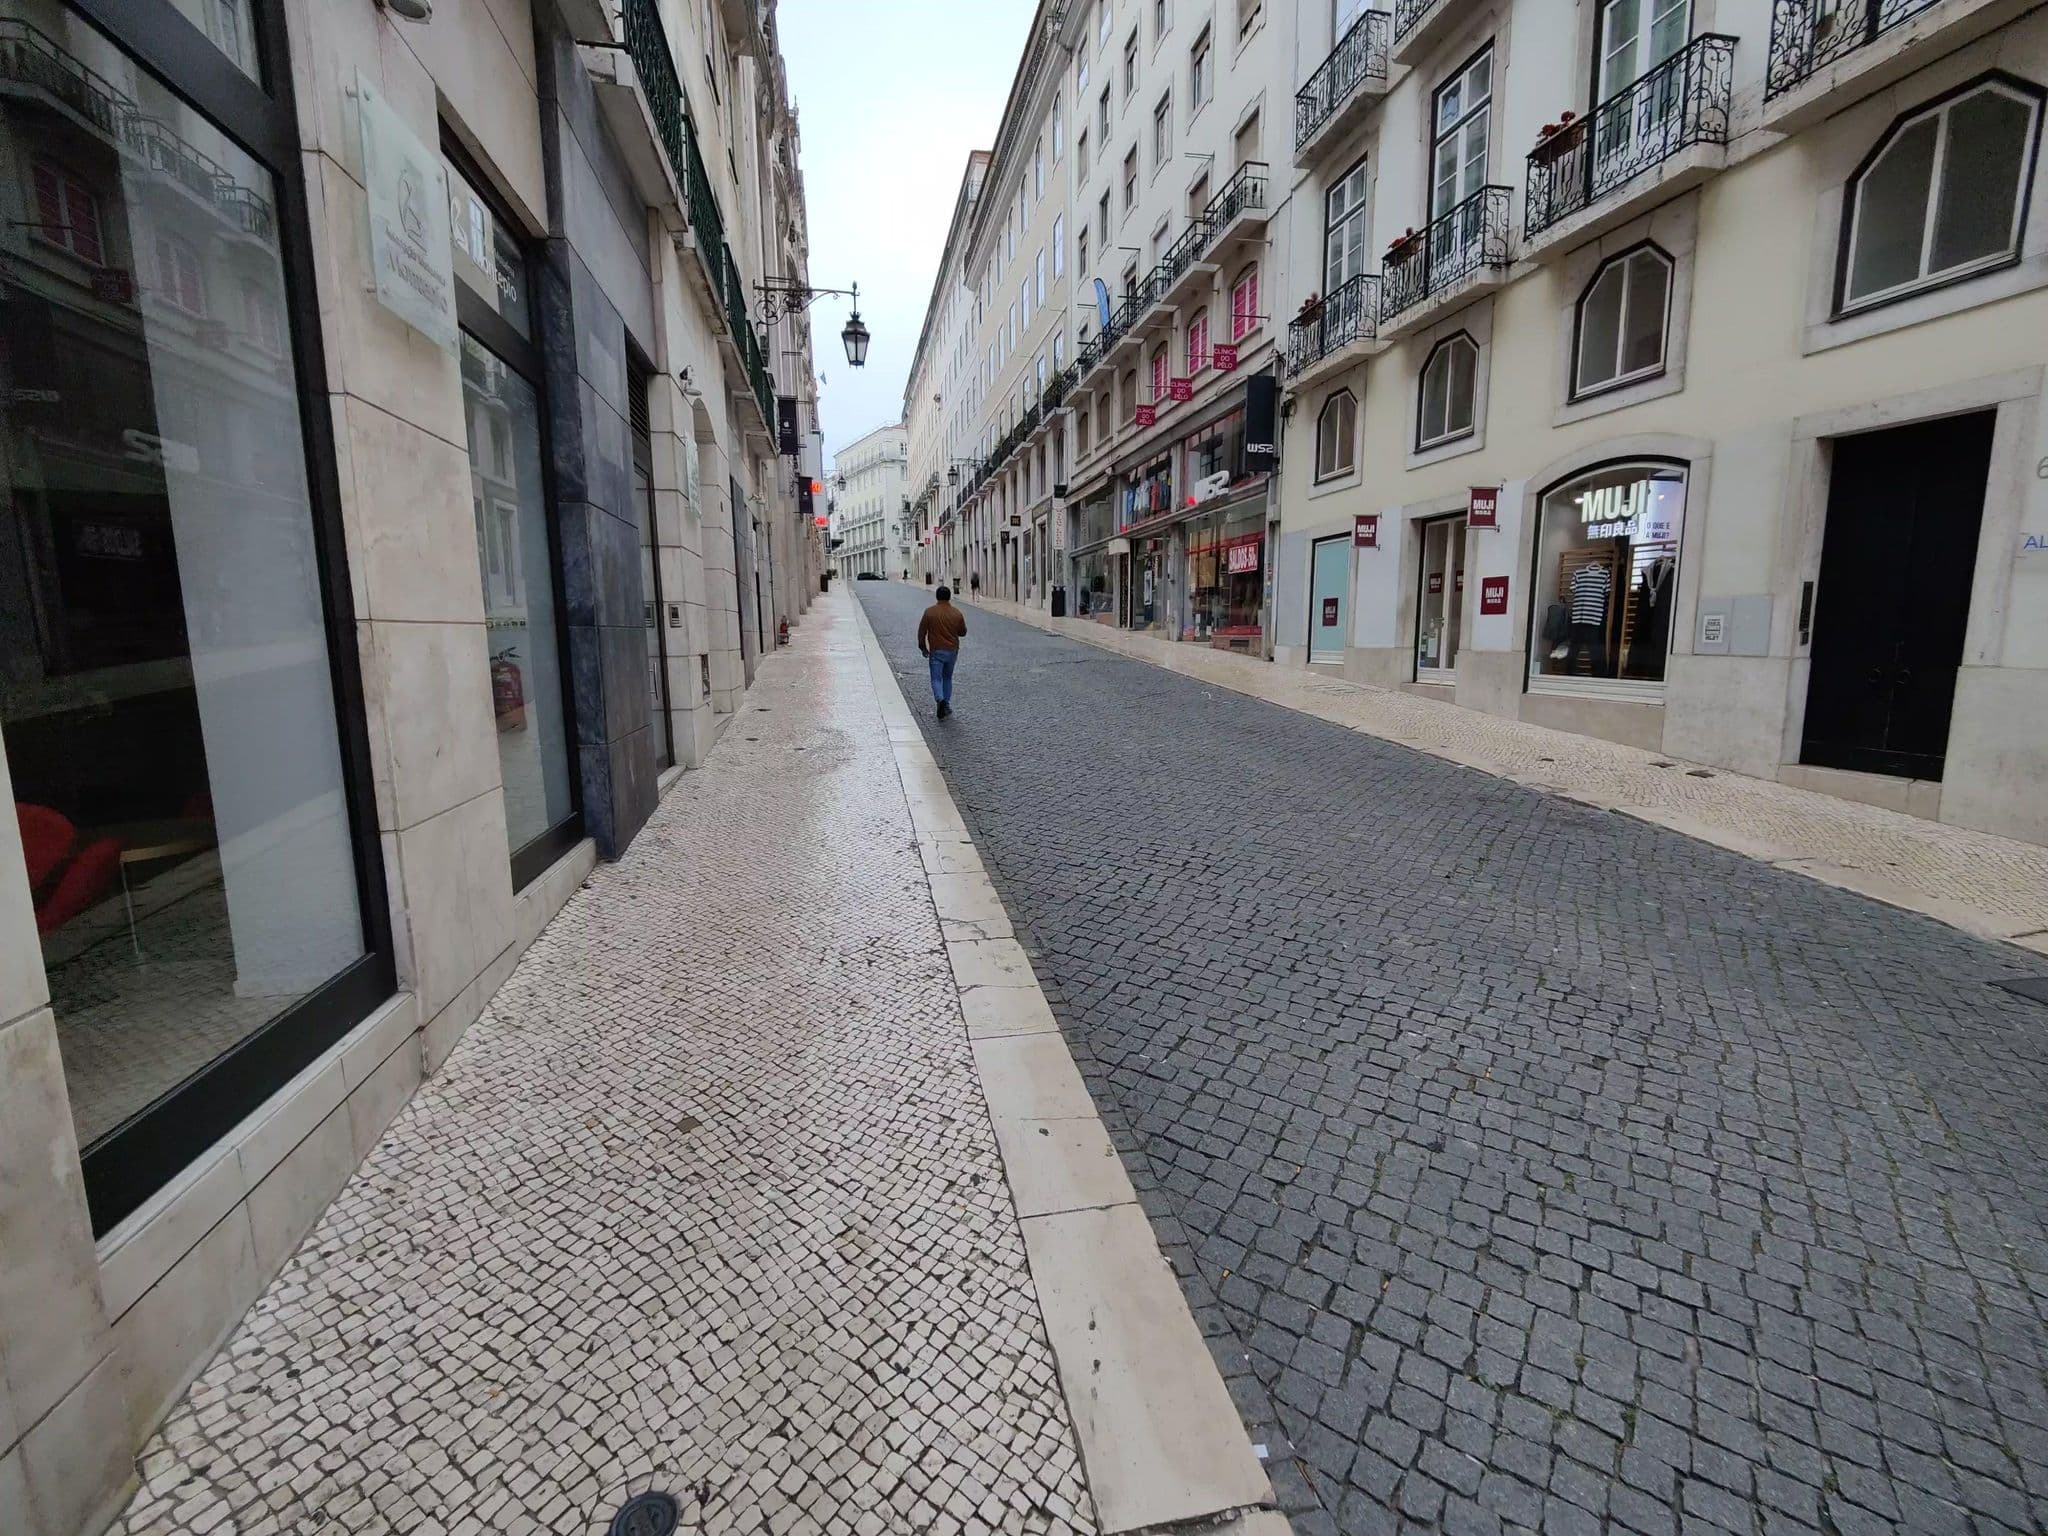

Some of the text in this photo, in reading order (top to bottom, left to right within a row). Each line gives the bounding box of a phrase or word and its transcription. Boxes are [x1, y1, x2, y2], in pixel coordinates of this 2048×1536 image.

[473, 250, 517, 302] ontepio
[1473, 499, 1495, 510] MUJI
[1581, 480, 1647, 523] MUJI
[1357, 524, 1375, 533] MUJI
[1485, 587, 1504, 598] MUJI
